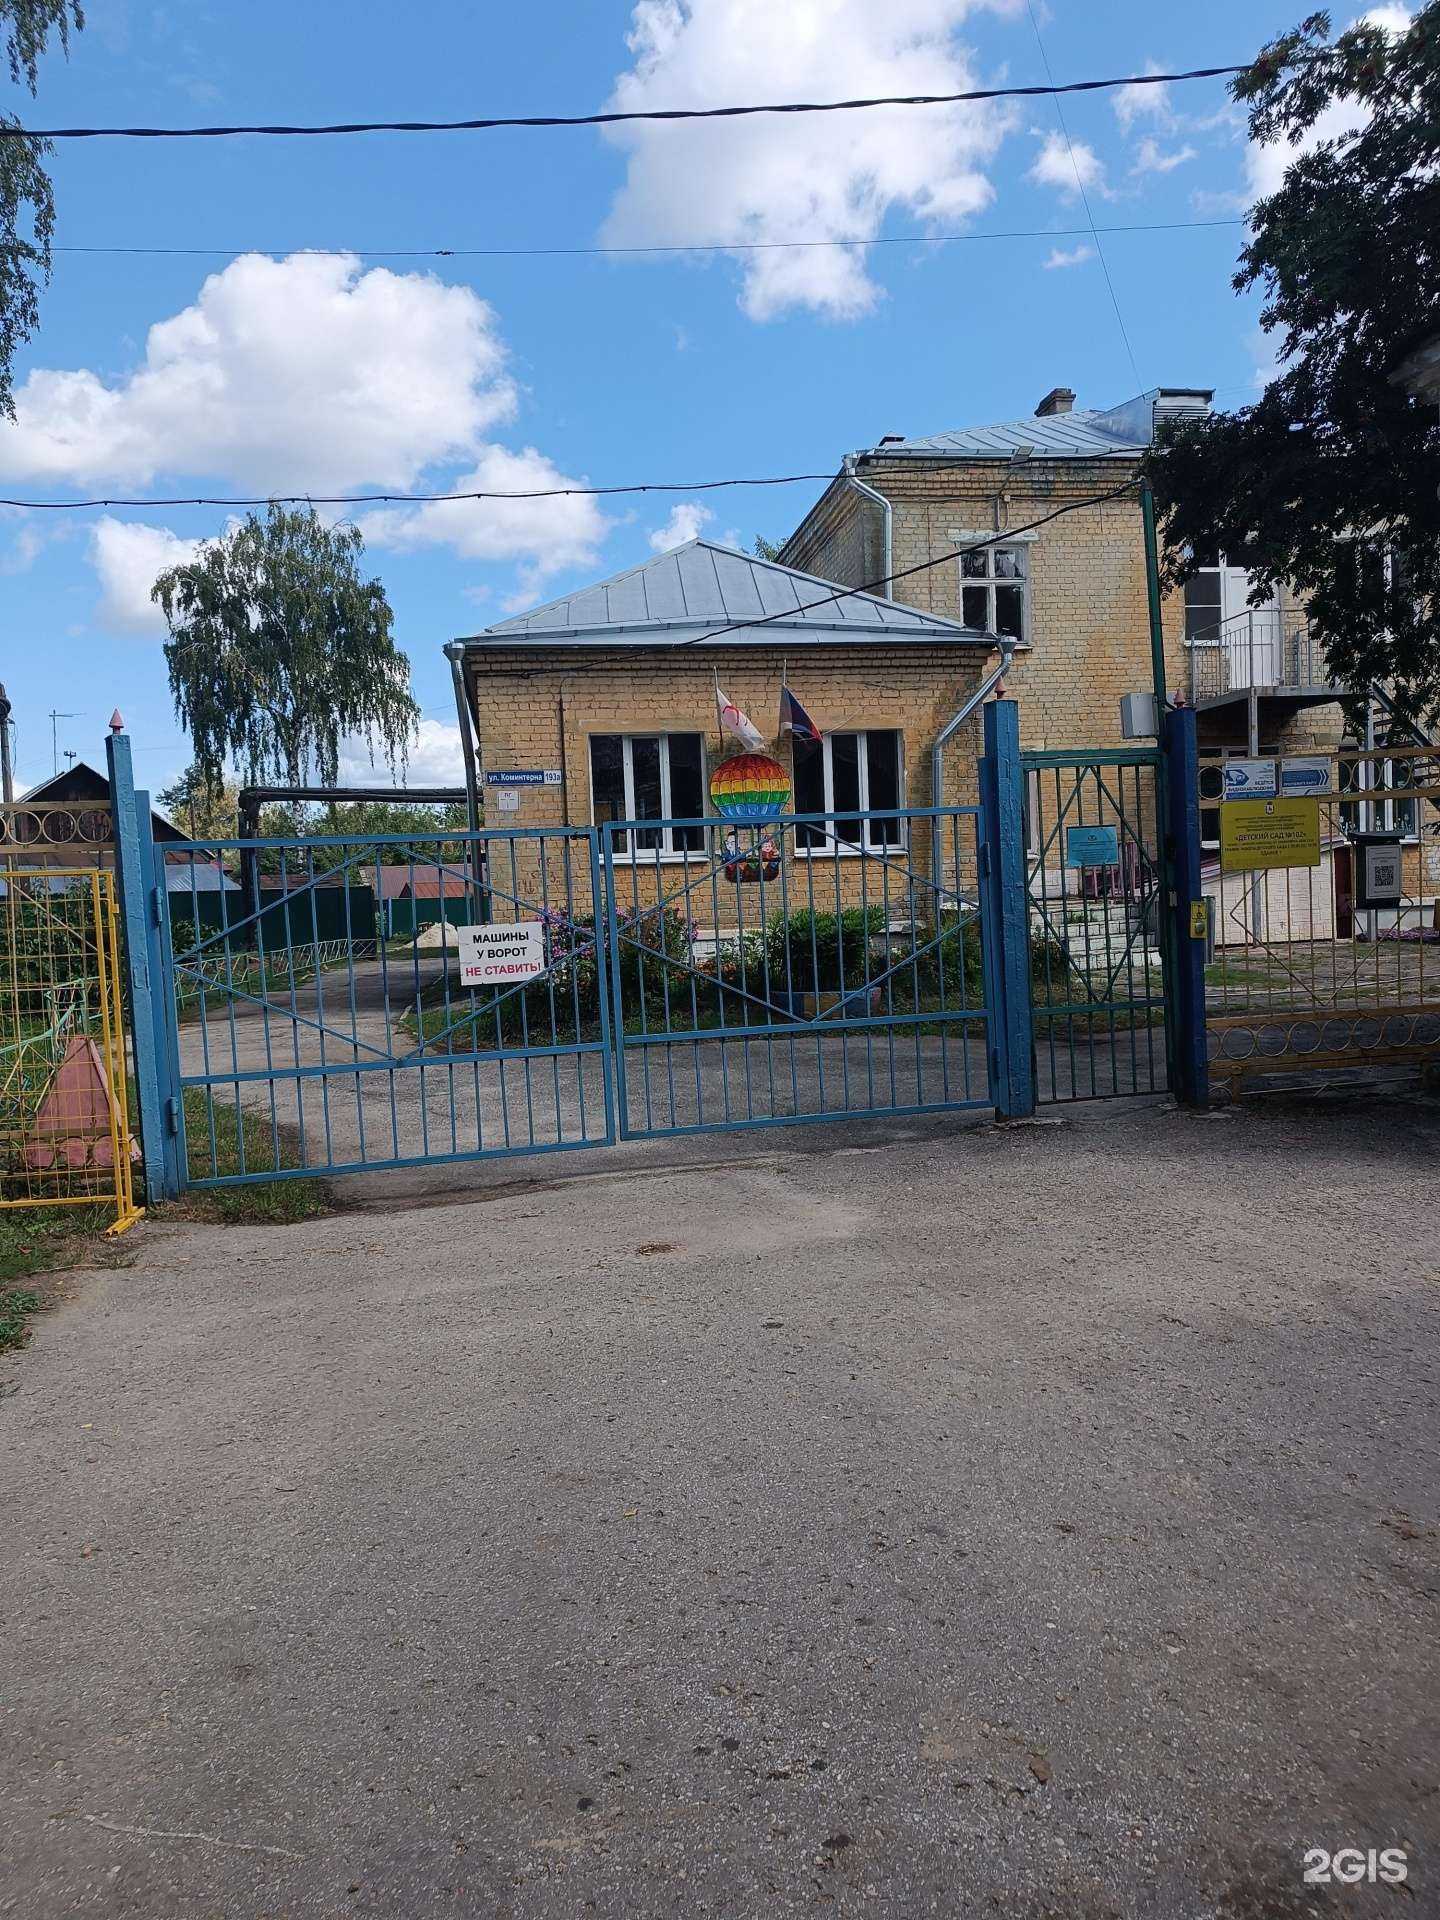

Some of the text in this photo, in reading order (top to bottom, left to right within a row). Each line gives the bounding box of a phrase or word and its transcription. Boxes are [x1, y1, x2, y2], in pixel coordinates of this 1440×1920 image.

[488, 775, 499, 783] ул.
[500, 773, 543, 782] Коминтерна
[1270, 832, 1284, 840] САД
[472, 931, 529, 944] МАШИНЫ
[476, 947, 528, 960] У ВОРОТ
[465, 967, 482, 977] НЕ
